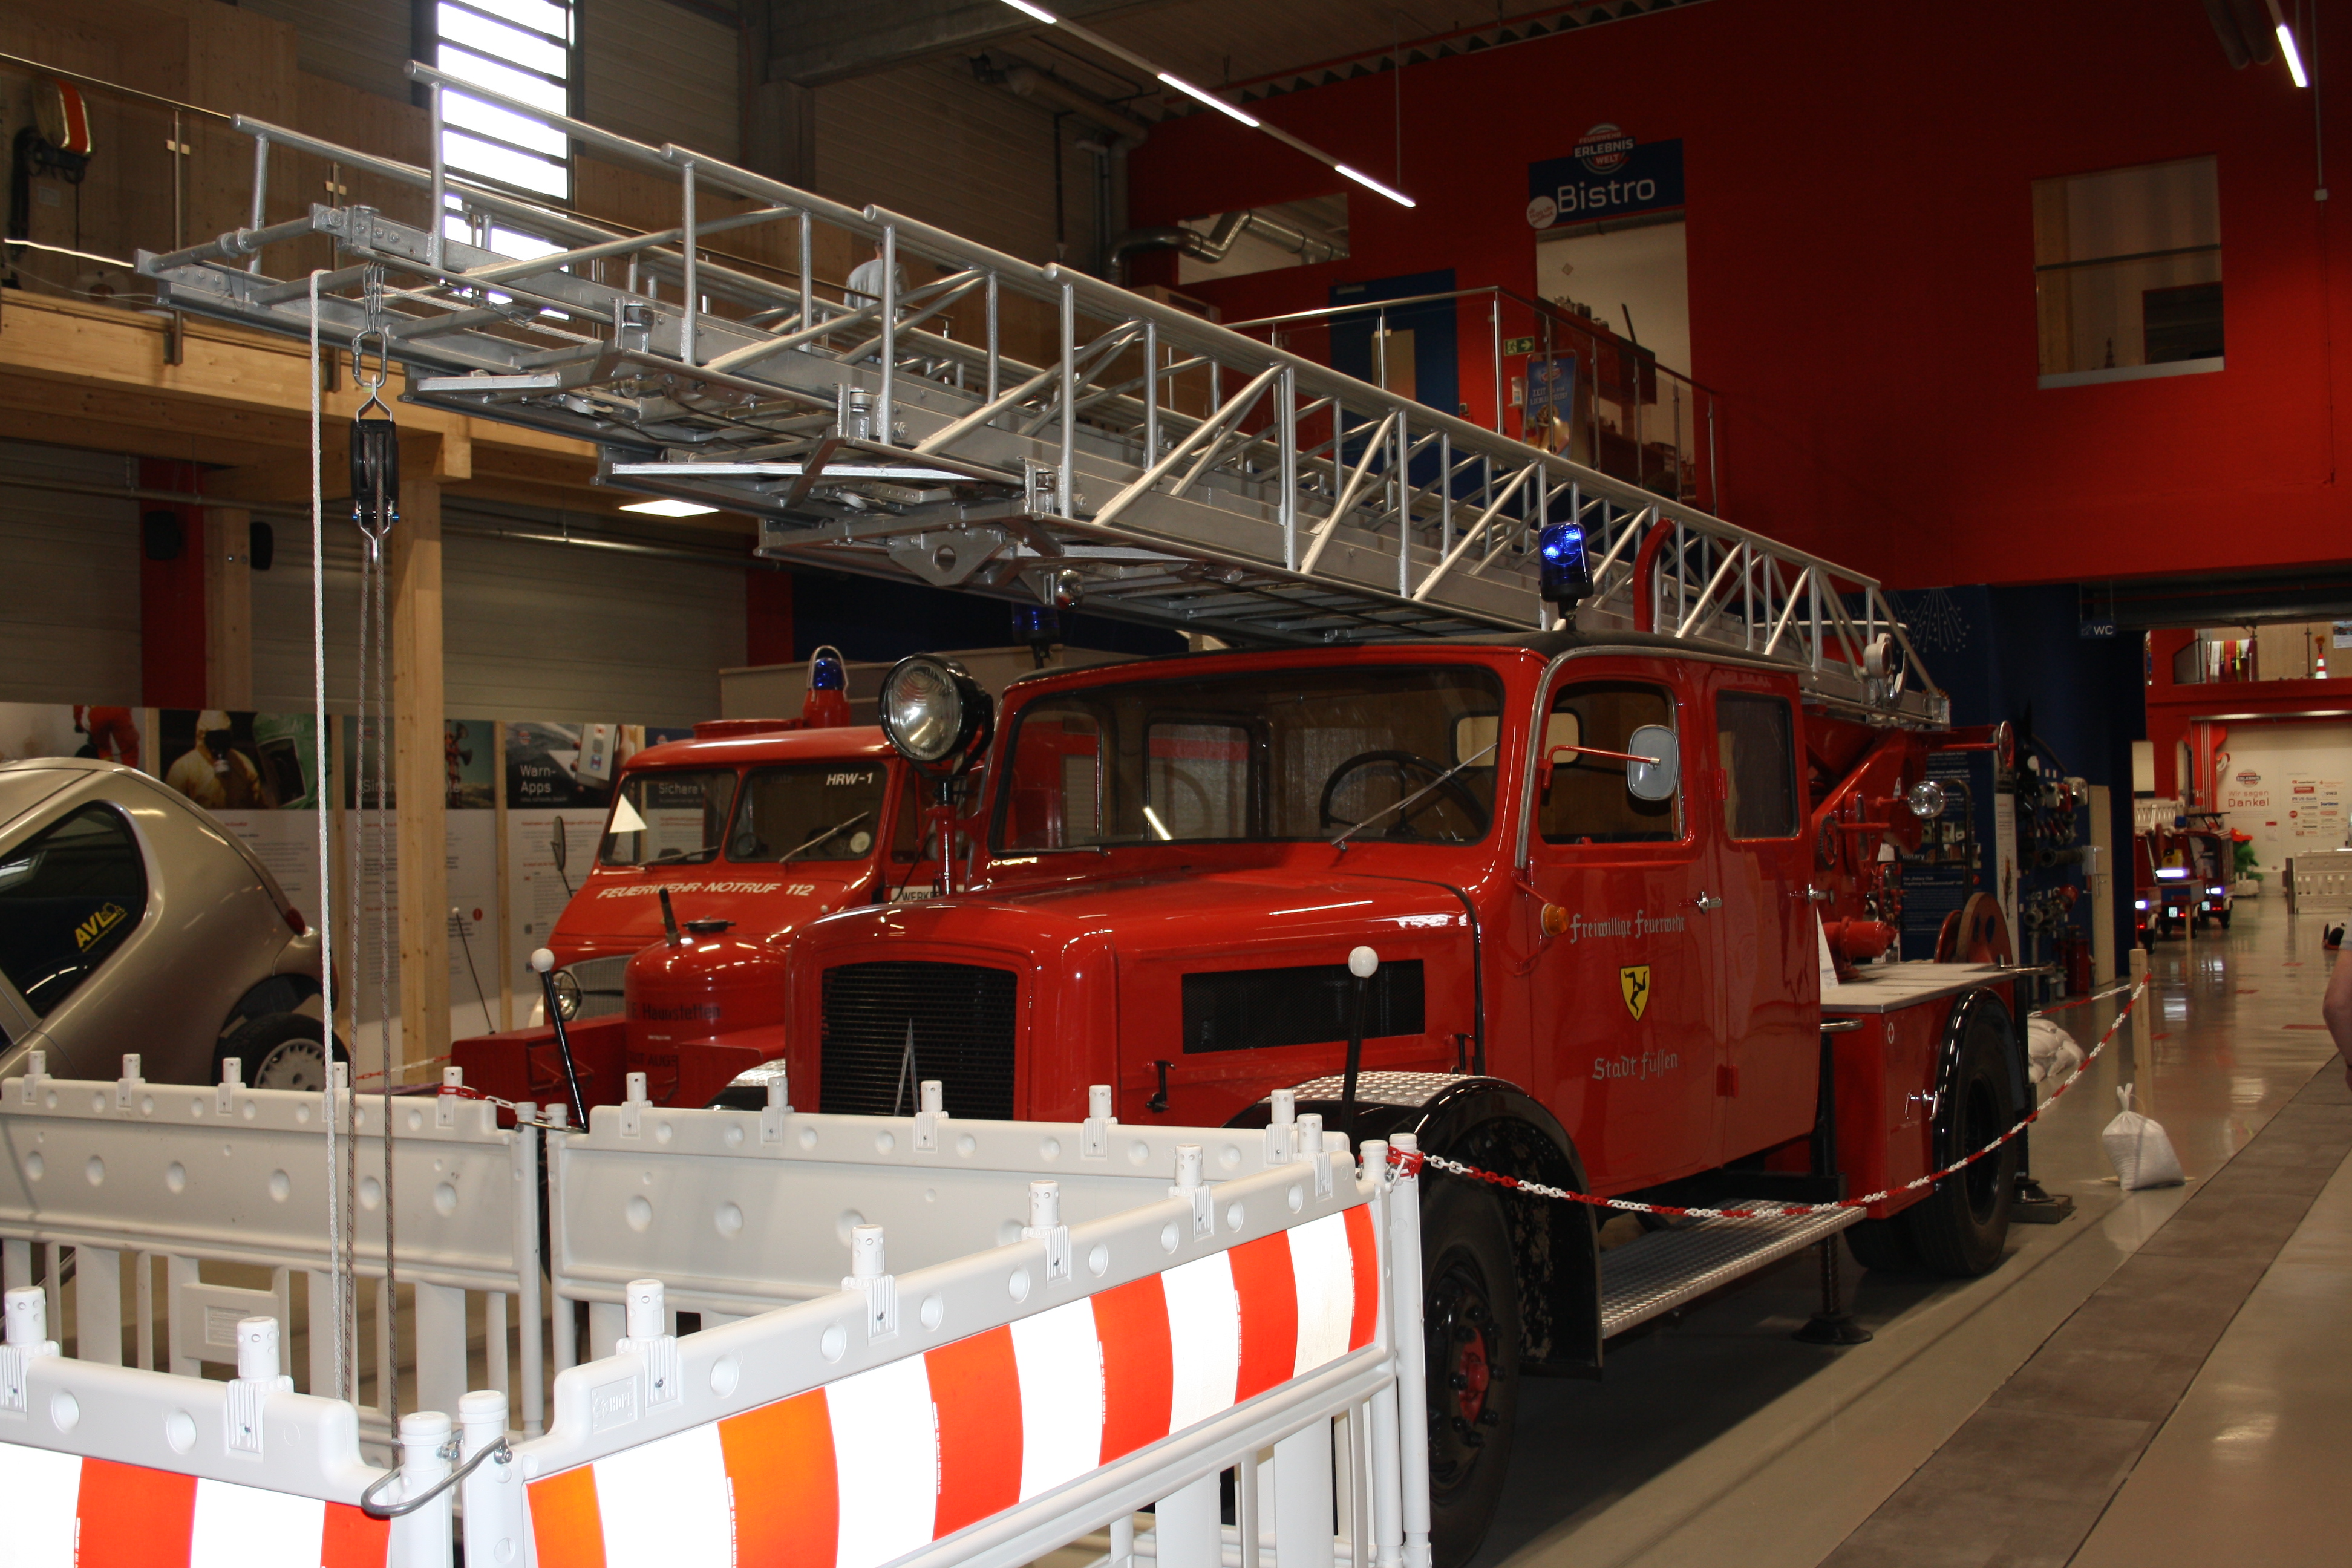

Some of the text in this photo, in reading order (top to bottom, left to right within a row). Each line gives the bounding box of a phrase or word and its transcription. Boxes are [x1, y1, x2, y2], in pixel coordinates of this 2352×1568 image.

[1579, 131, 1621, 144] FEUERWEHR
[1574, 139, 1634, 158] ERLEBNIS
[1595, 154, 1620, 165] WELT
[1557, 178, 1656, 214] Bistro
[2093, 625, 2114, 635] WC
[520, 764, 557, 777] Warn-
[826, 772, 874, 786] HRW-1
[520, 780, 552, 796] Apps
[786, 884, 815, 897] 112
[74, 911, 119, 948] AVL
[643, 1003, 720, 1021] Haunstetten
[1591, 1054, 1637, 1081] Stadt
